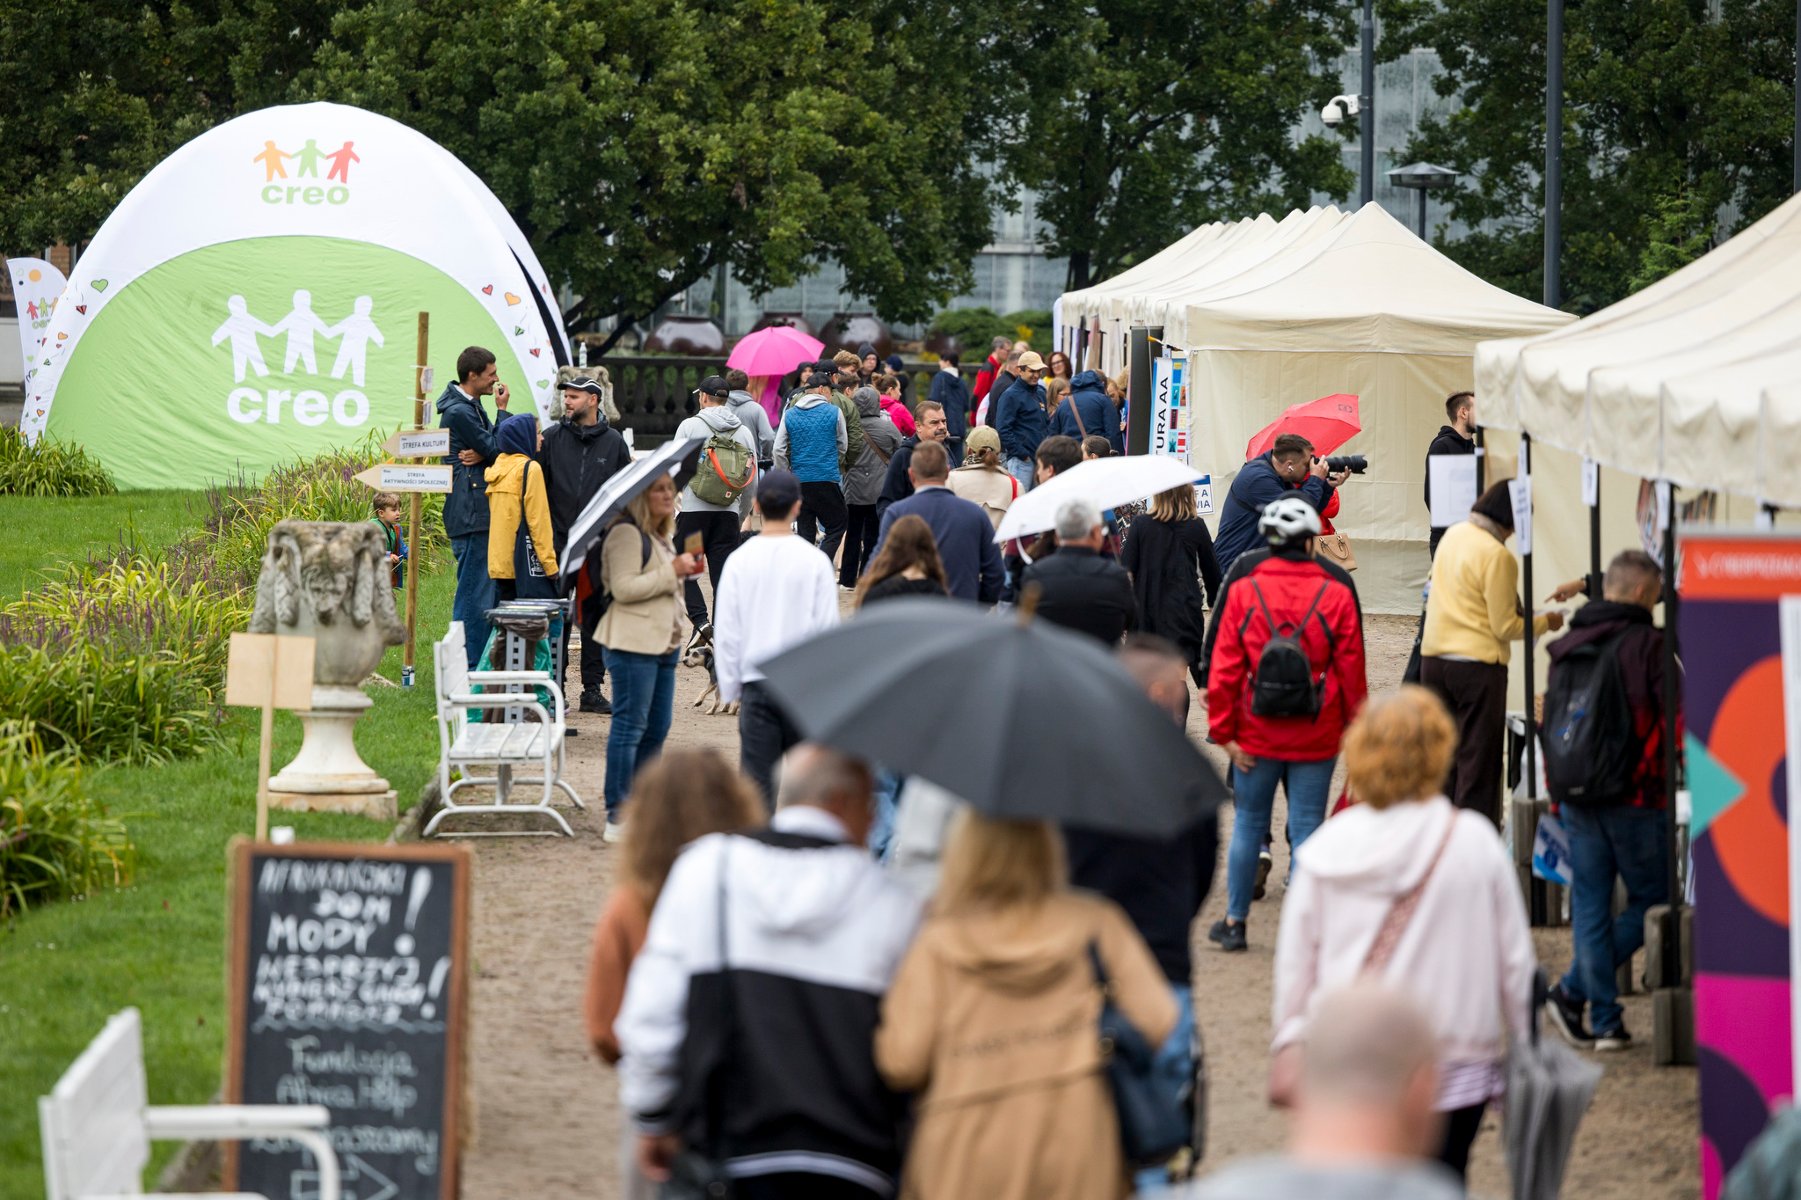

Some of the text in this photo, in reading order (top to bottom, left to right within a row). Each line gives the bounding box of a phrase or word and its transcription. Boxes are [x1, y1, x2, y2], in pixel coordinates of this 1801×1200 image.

[261, 184, 350, 206] creo
[227, 387, 371, 427] creo
[313, 888, 392, 926] DOM
[266, 912, 377, 955] MODY
[286, 1034, 418, 1080] Fundacja
[357, 1073, 418, 1120] Help
[250, 1124, 438, 1176] Zaaszamy
